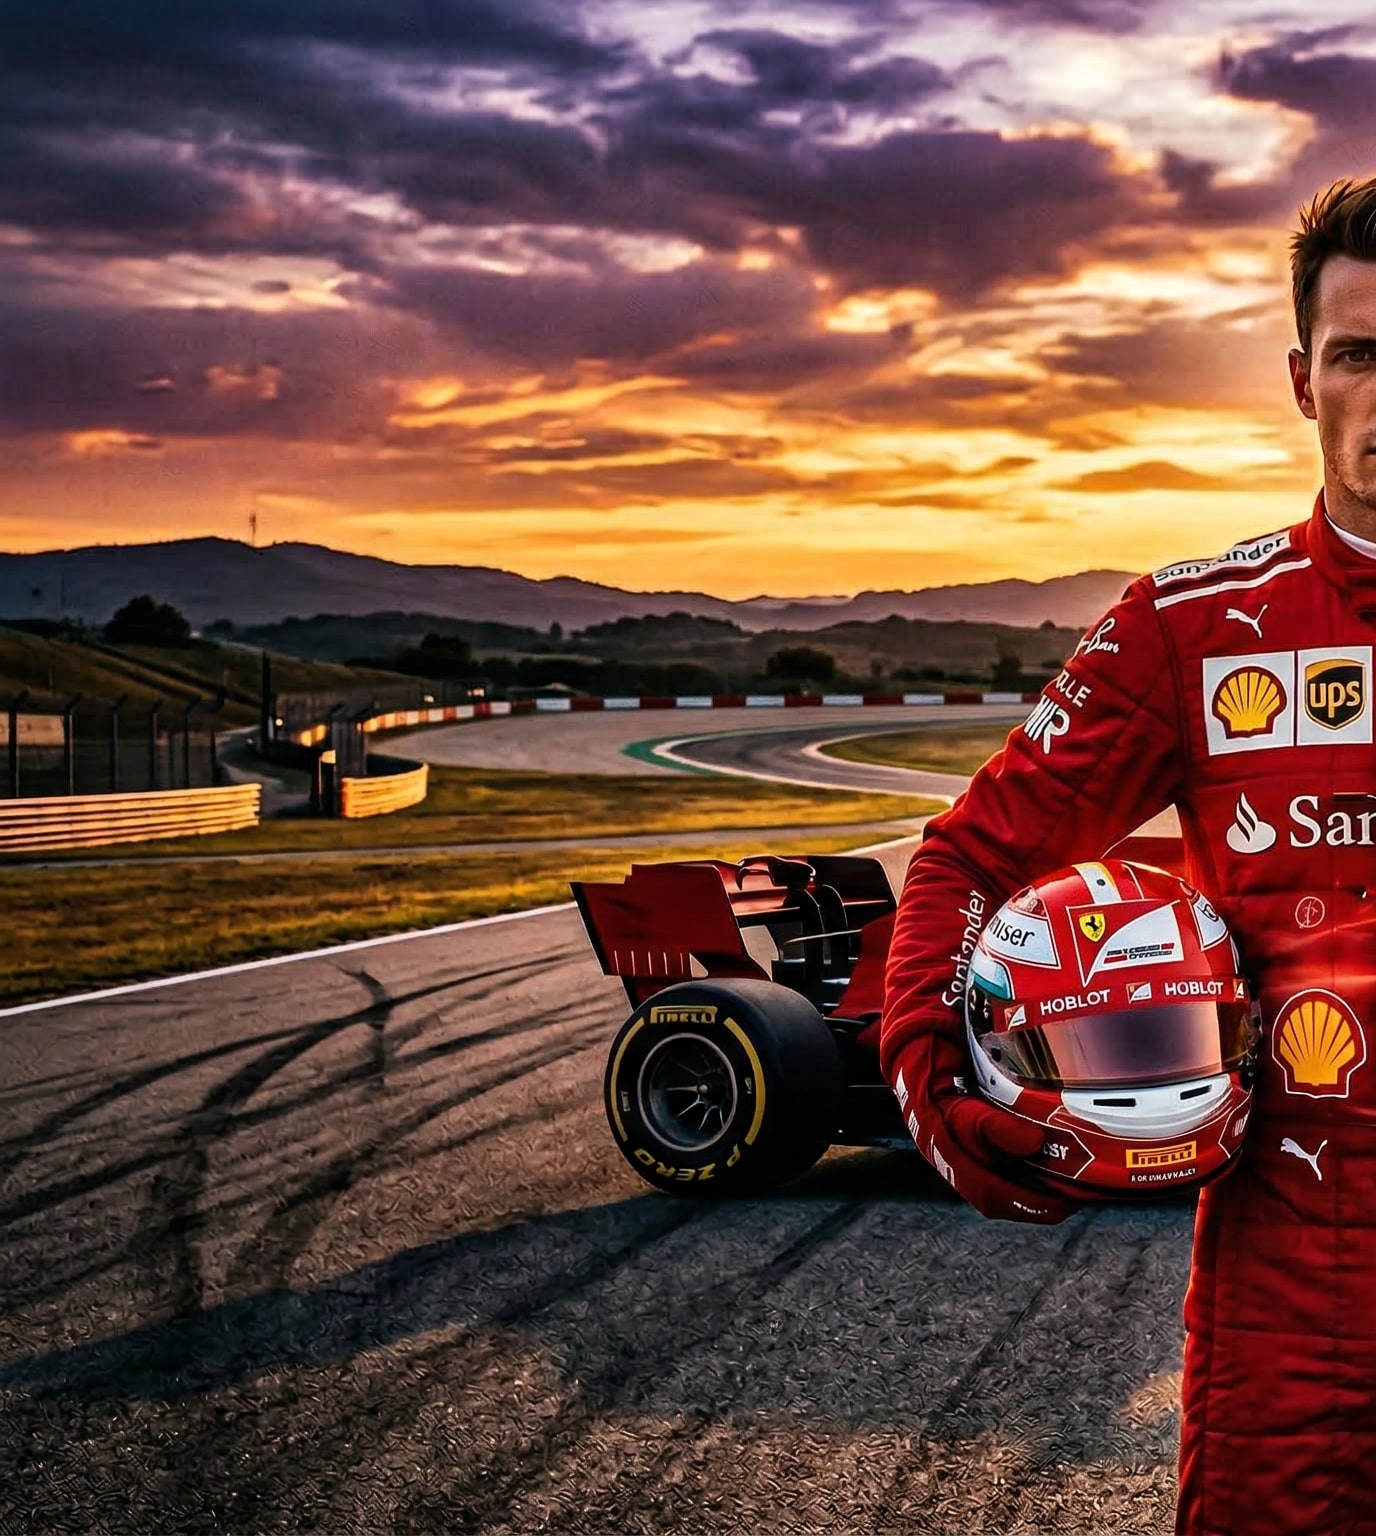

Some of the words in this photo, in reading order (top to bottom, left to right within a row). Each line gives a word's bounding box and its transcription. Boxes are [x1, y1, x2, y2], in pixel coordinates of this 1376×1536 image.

[1309, 681, 1361, 719] ups
[1040, 989, 1111, 1016] HOBLOT
[1164, 980, 1224, 996] HOBLOT
[634, 1148, 716, 1181] ZERO
